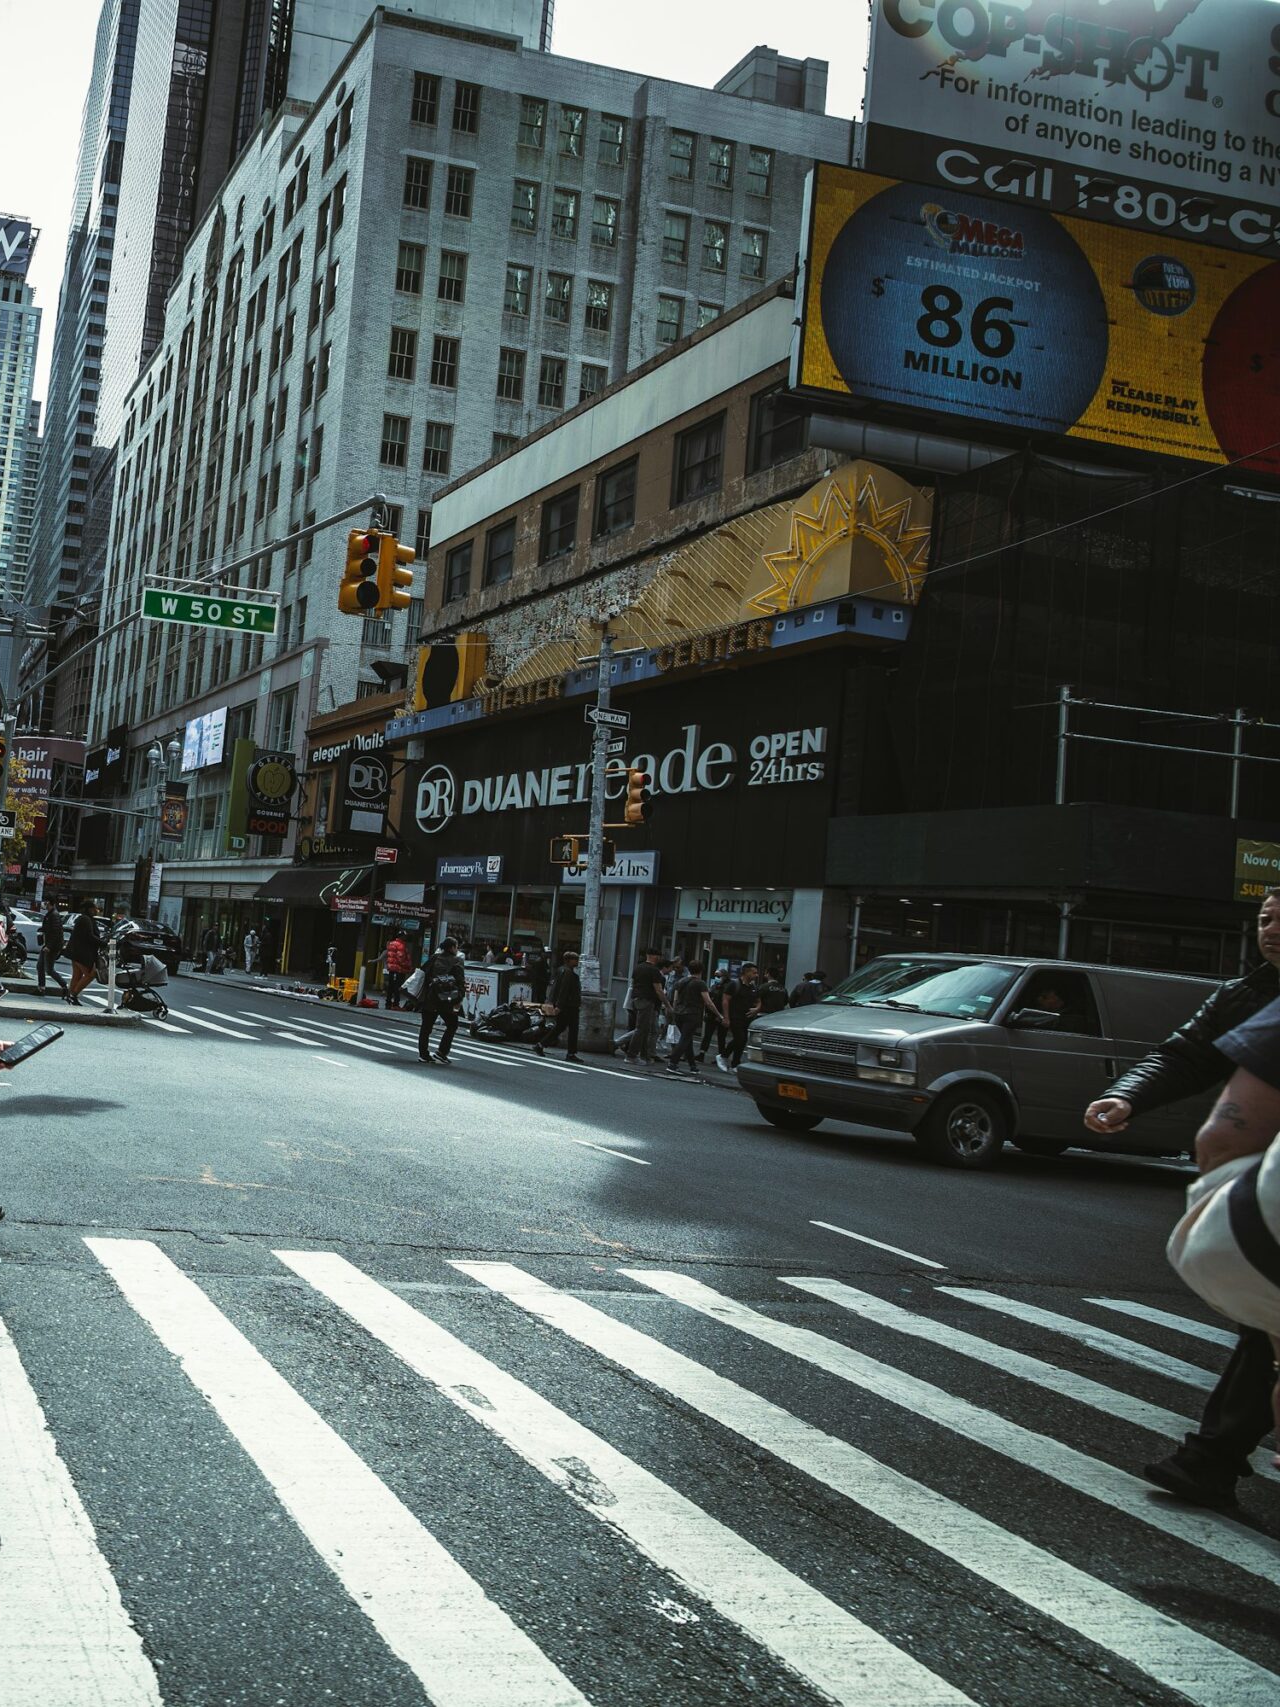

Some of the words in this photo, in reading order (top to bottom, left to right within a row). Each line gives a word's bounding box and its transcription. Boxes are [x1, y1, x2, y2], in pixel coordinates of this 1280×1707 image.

[940, 68, 979, 95] For
[988, 78, 1122, 126] information
[1132, 110, 1216, 151] leading
[1224, 130, 1245, 151] to
[1005, 114, 1029, 135] of
[1036, 123, 1121, 154] anyone
[1129, 141, 1232, 182] shooting
[1240, 166, 1251, 181] a
[936, 150, 1052, 200] Call
[1074, 174, 1280, 244] 1-800-C
[956, 214, 1023, 248] MEGA
[907, 256, 980, 278] ESTIMATED
[983, 272, 1040, 292] JACKPOT
[916, 284, 1016, 358] 86
[903, 350, 1023, 391] MILLION
[1112, 386, 1162, 405] PLEASE
[1165, 395, 1198, 411] PLAY
[161, 596, 180, 615] W
[190, 599, 222, 621] 50
[232, 604, 261, 626] ST
[655, 621, 772, 672] CENTER
[594, 711, 607, 720] ONE
[610, 715, 624, 723] WAY
[19, 747, 48, 762] hair
[353, 733, 385, 751] Nails
[609, 743, 621, 751] WAY
[750, 727, 826, 760] OPEN
[18, 765, 52, 780] minu
[349, 763, 386, 792] DR
[748, 758, 824, 785] 24hrs
[417, 773, 453, 820] DR
[250, 819, 287, 834] FOOD
[256, 809, 285, 818] GOURMET
[440, 862, 475, 877] pharmacy
[567, 861, 606, 877] OPN
[626, 859, 649, 876] hrs
[1243, 853, 1269, 866] Now
[1240, 883, 1270, 897] SUB
[696, 892, 792, 922] pharmacy
[464, 983, 490, 996] EAVEN
